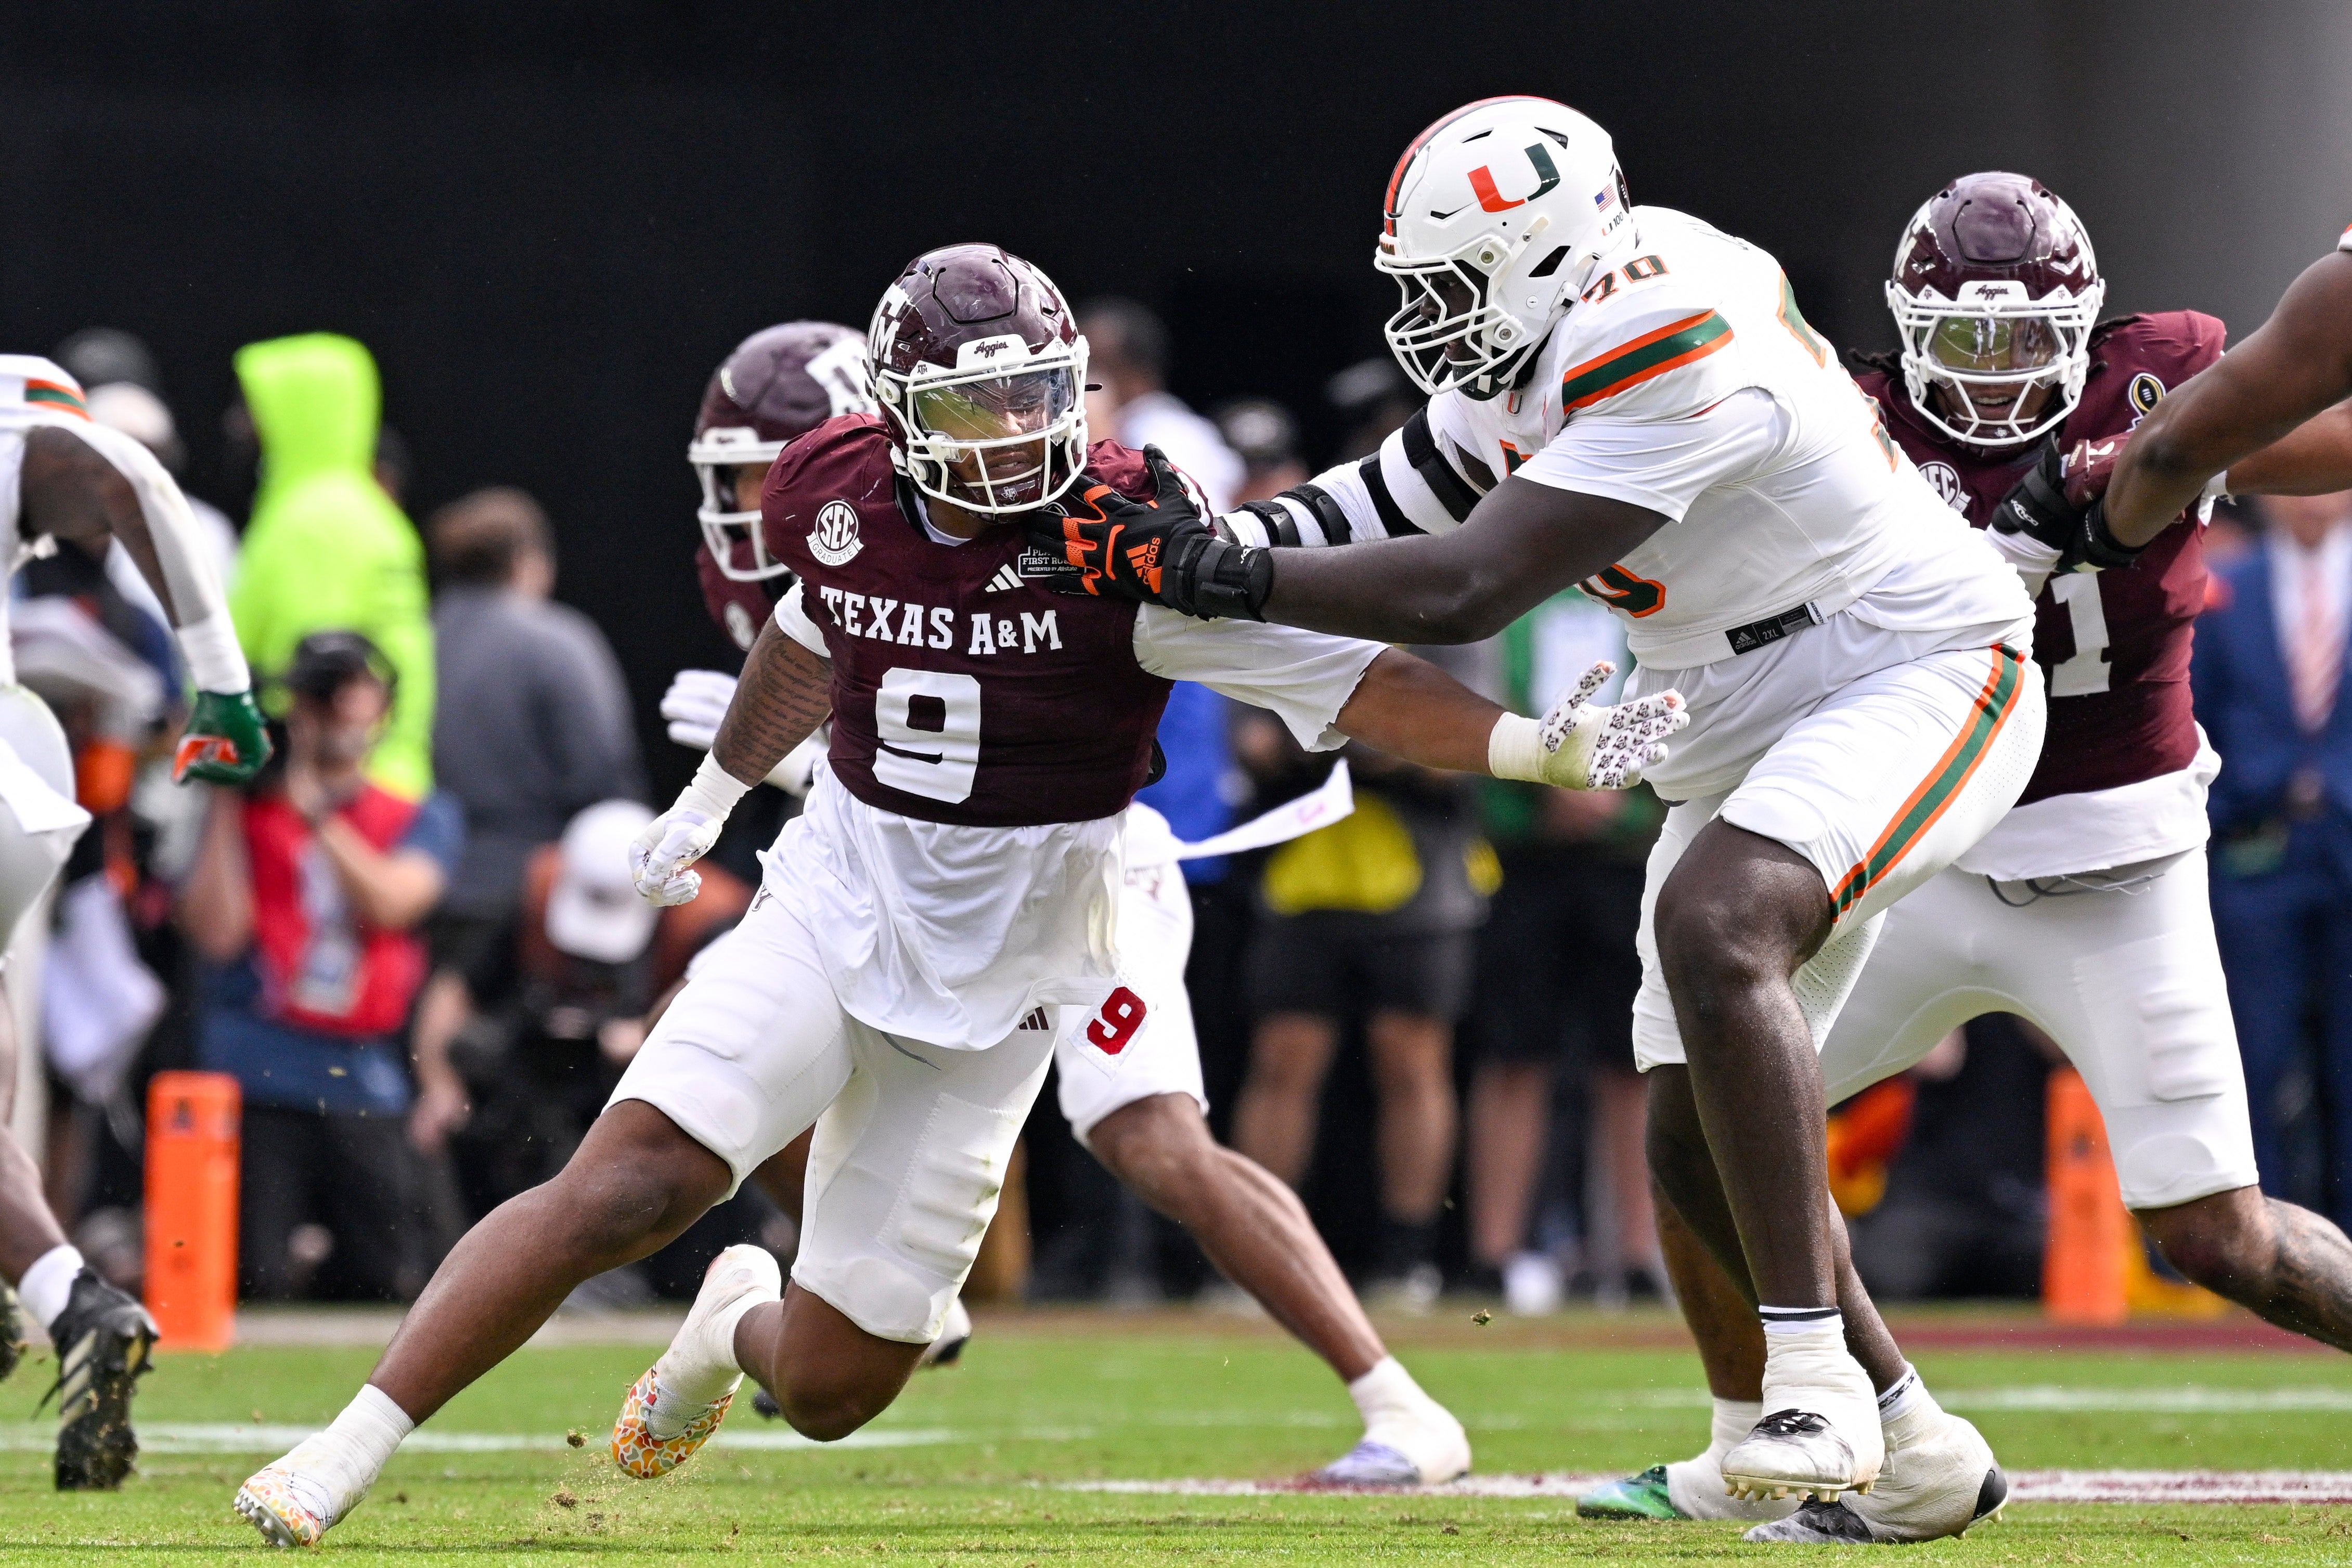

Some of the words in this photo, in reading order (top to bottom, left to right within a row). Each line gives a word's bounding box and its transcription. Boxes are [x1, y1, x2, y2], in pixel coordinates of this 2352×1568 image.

[1613, 211, 1623, 227] 100
[1975, 284, 2009, 301] Aggies
[974, 340, 1009, 358] Aggies
[1920, 465, 1956, 504] EC
[819, 504, 855, 549] SEC
[812, 543, 854, 564] GRADUATE
[820, 585, 954, 651] TEXAS
[968, 610, 1063, 655] A&M
[1762, 628, 1779, 640] 2XL
[2051, 572, 2112, 697] 1
[1735, 639, 1757, 650] adidas
[872, 667, 980, 804] 9
[1087, 986, 1147, 1055] 9
